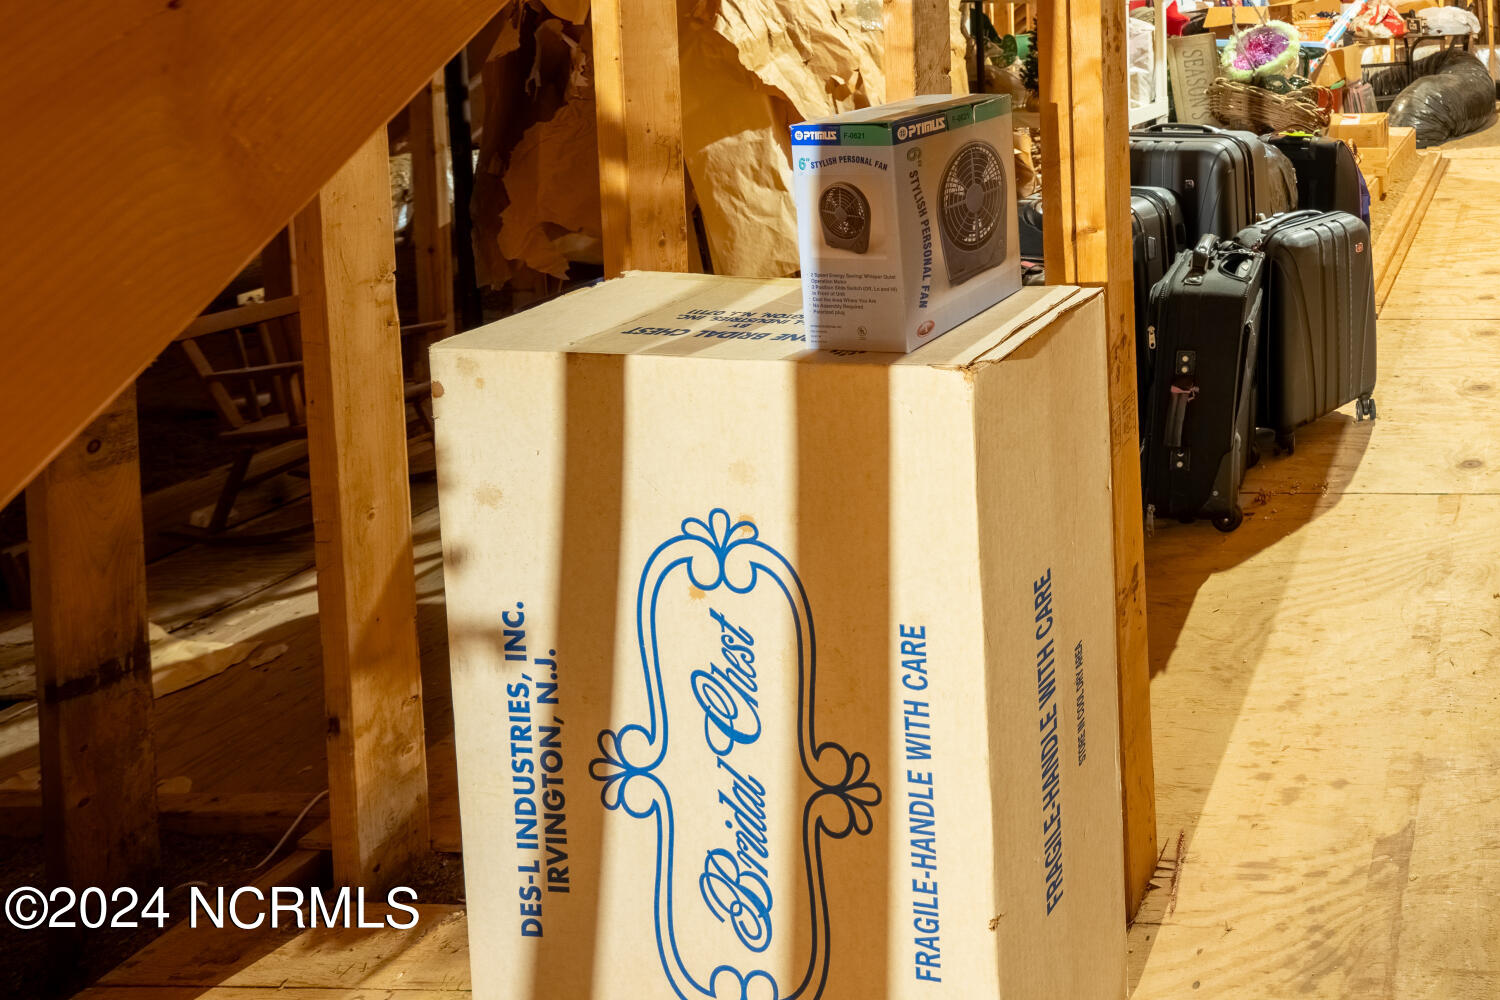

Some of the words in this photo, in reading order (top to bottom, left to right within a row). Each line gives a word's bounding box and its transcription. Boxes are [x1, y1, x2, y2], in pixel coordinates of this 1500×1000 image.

[794, 130, 838, 141] OPTIMUS
[896, 117, 946, 140] OPTIMUS
[810, 156, 838, 169] STYLISH
[838, 155, 873, 167] PERSONAL
[874, 160, 888, 172] FAN
[909, 169, 928, 218] STYLISH
[920, 219, 933, 281] PERSONAL
[918, 285, 931, 309] FAN
[620, 326, 690, 336] CHEST
[693, 329, 771, 340] BRIDAL
[501, 601, 527, 662] INC.
[1033, 567, 1051, 641] CARE
[534, 649, 559, 704] N.J.
[690, 608, 761, 757] Chest
[899, 623, 929, 692] CARE
[1036, 638, 1056, 711] WITH
[1074, 639, 1083, 670] AREA
[1075, 668, 1084, 693] DRY
[903, 699, 932, 761] WITH
[1076, 688, 1085, 721] COOL
[1077, 717, 1085, 734] IN
[506, 672, 539, 850] INDUSTRIES,
[1077, 729, 1086, 767] STORE
[538, 716, 570, 893] IRVINGTON,
[1039, 703, 1064, 917] FRAGILE-HANDLE
[699, 756, 773, 953] Bridal
[906, 769, 942, 983] FRAGILE-HANDLE
[518, 859, 543, 938] DES-L
